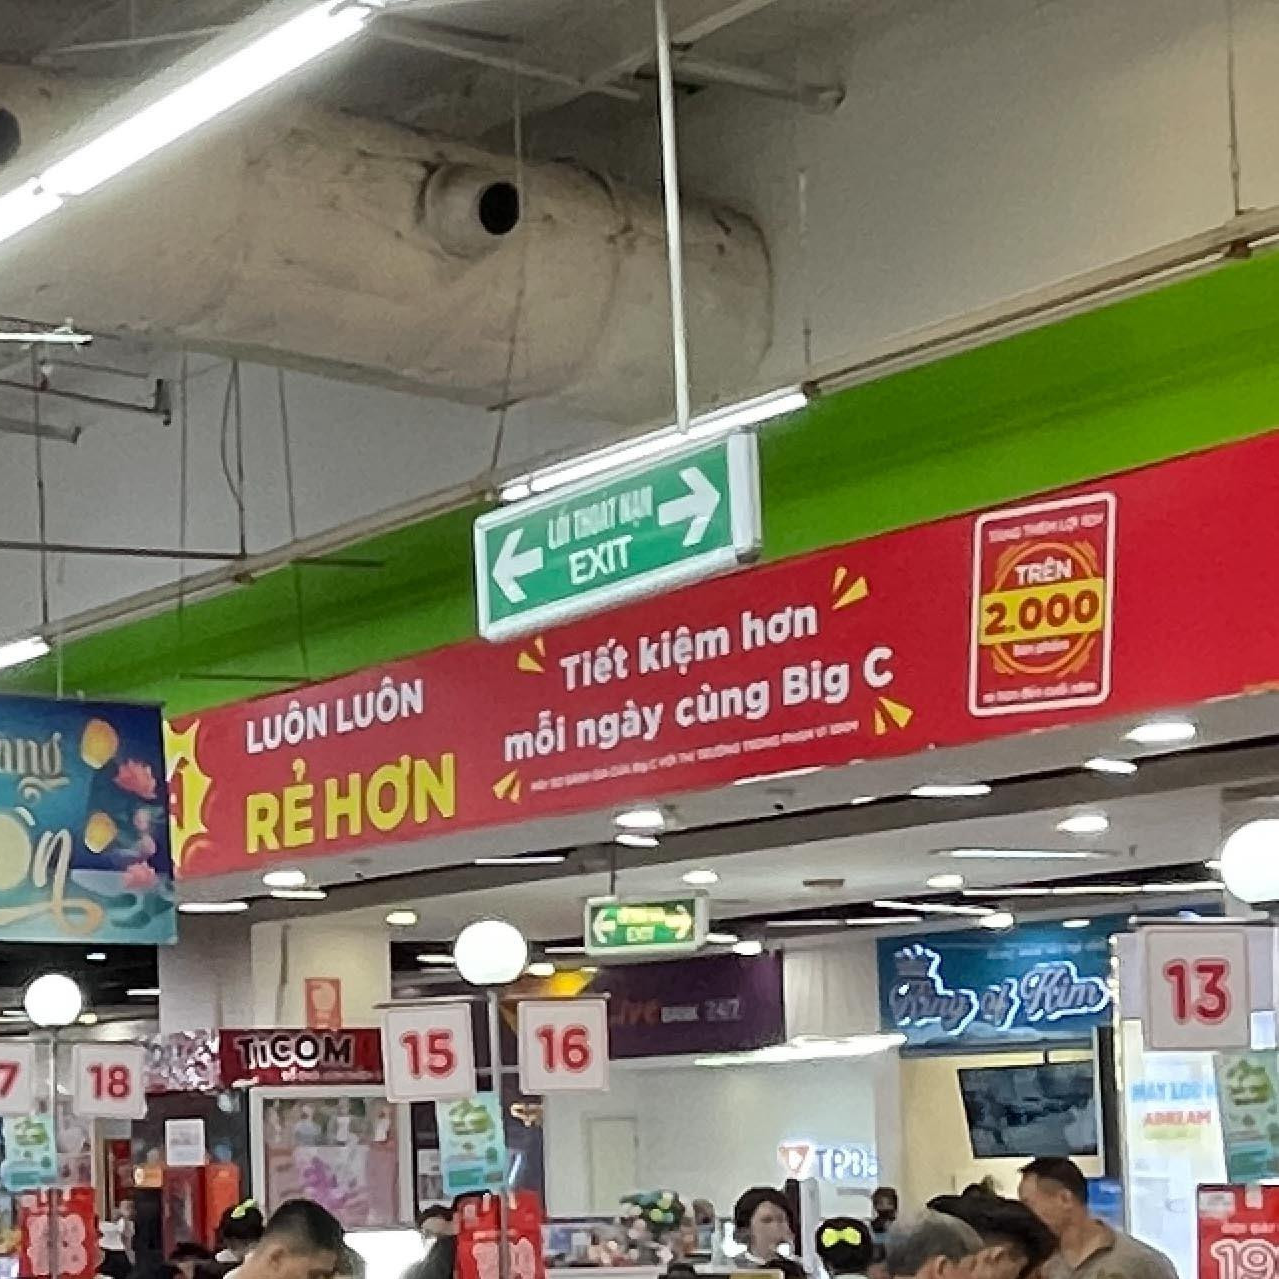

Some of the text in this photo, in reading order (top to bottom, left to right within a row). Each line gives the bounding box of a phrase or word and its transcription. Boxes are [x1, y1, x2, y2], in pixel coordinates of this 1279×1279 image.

[568, 534, 633, 585] EXIT
[985, 589, 1100, 636] 2.000
[559, 605, 818, 692] Tiết kiệm hơn
[246, 676, 423, 753] LUÔN LUÔN
[504, 647, 893, 762] mỗi ngày cùng Big C
[246, 758, 314, 853] RẺ
[325, 753, 456, 839] HƠN
[1163, 958, 1231, 1023] 13
[400, 1029, 454, 1078] 15
[537, 1023, 592, 1072] 16
[88, 1063, 131, 1100] 18
